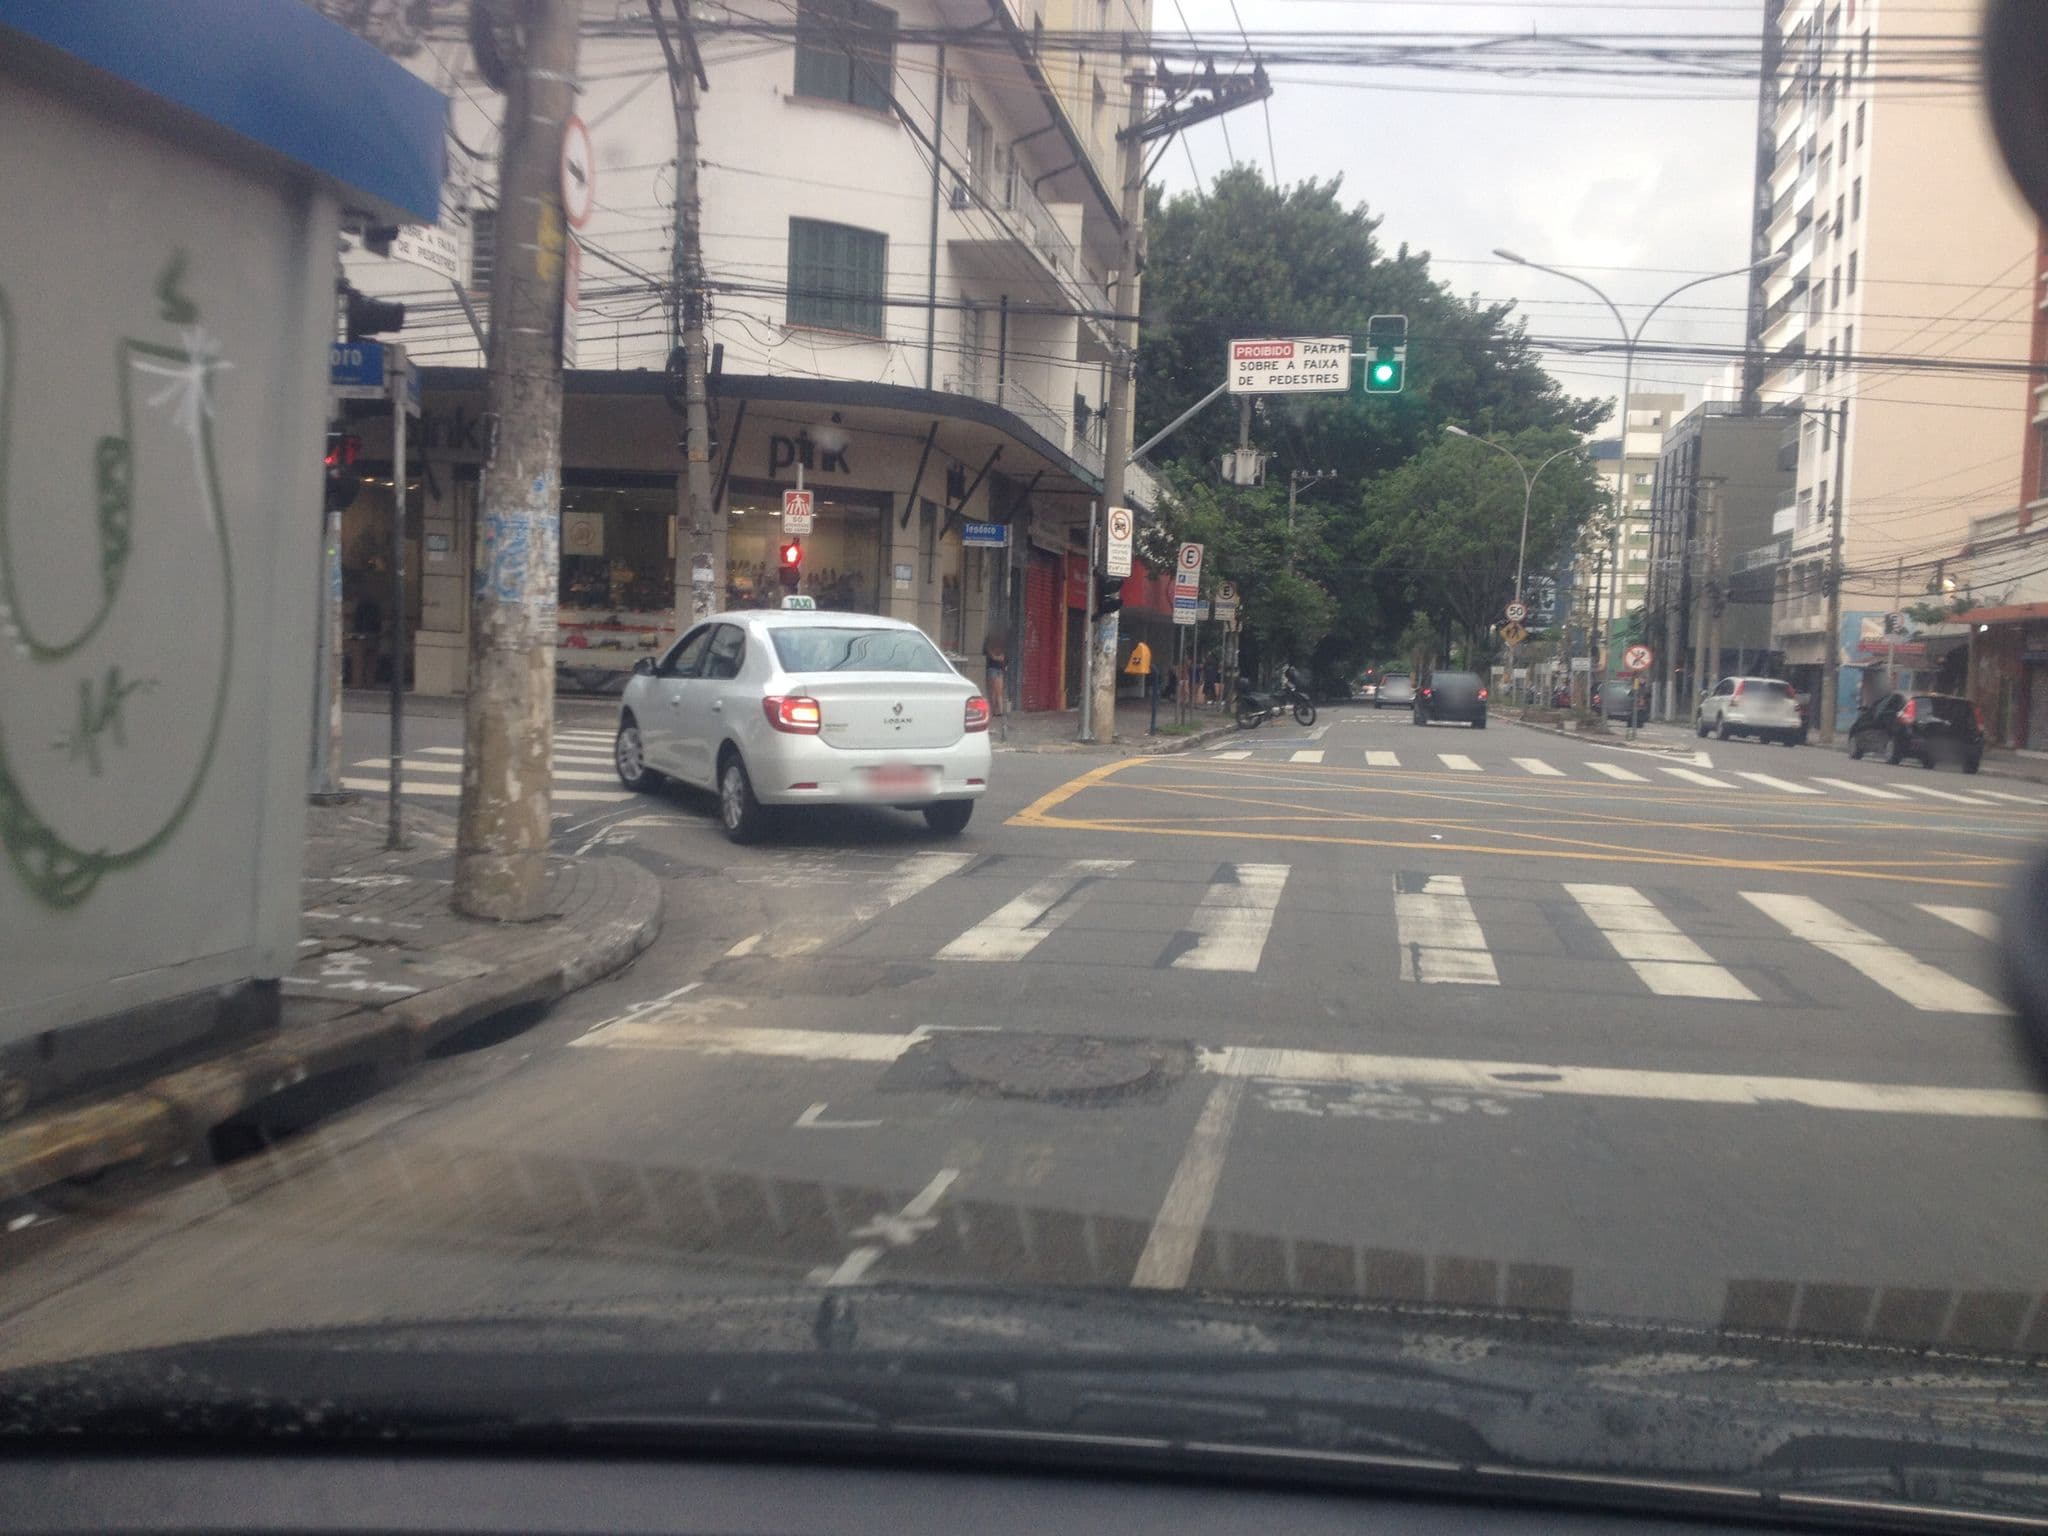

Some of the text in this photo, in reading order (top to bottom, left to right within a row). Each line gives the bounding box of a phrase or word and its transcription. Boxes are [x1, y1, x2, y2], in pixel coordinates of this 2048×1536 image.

[1236, 343, 1346, 357] PROIBIDO PARAR
[1239, 359, 1340, 371] SOBRE A FAIXA
[1238, 374, 1340, 386] DE PEDESTRES
[1186, 549, 1196, 564] E
[1223, 585, 1231, 596] E
[788, 598, 812, 609] TAXI
[1509, 606, 1523, 616] 50
